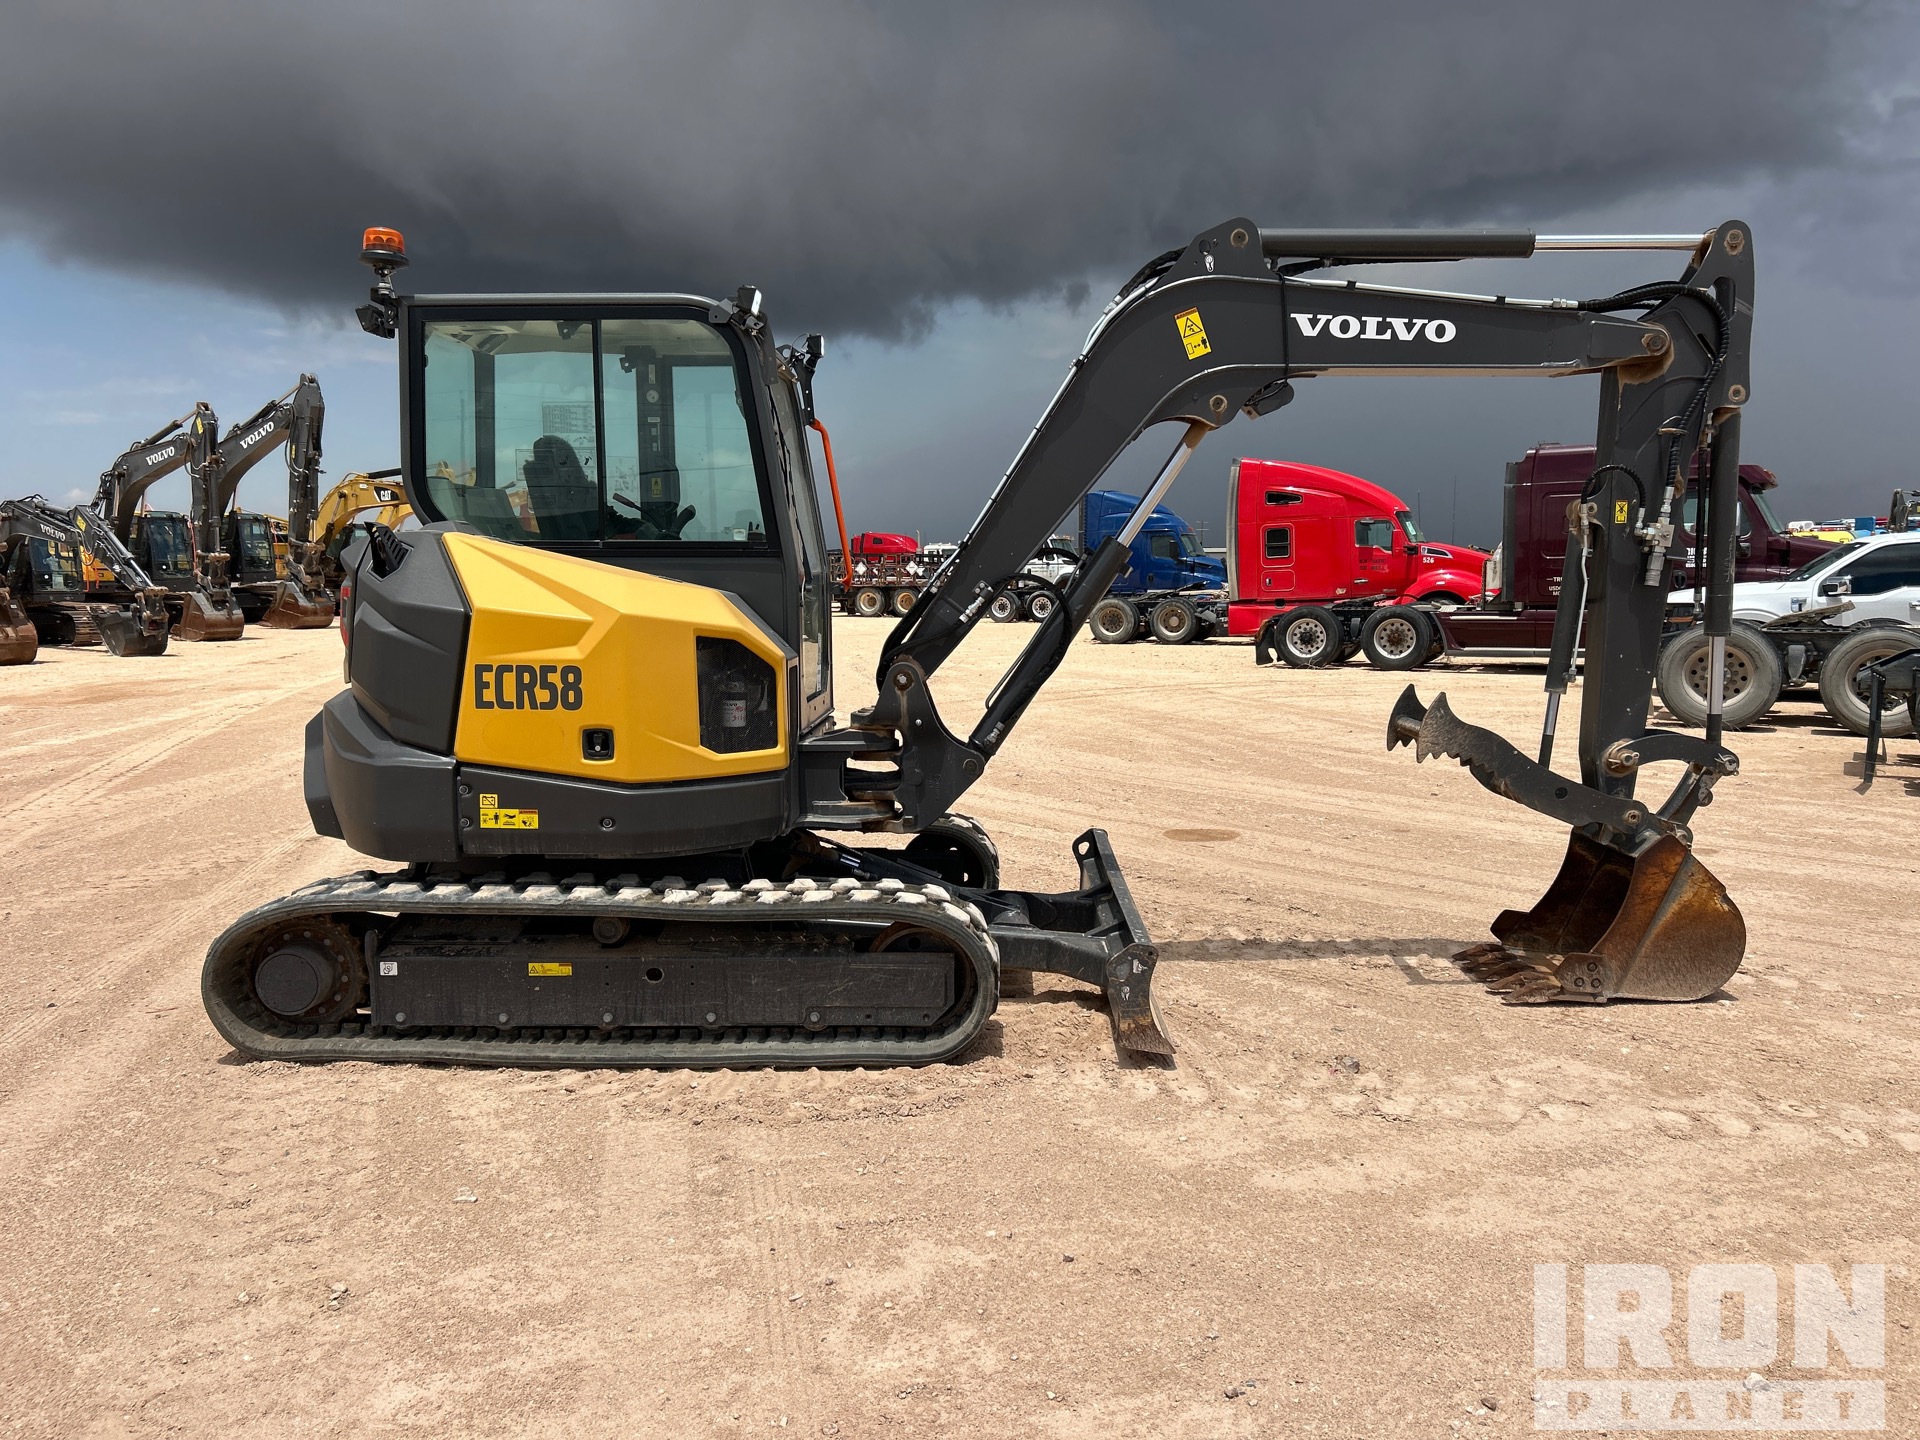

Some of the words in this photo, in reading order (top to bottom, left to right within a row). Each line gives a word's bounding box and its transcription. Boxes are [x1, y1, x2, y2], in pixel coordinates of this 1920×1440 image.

[1290, 313, 1457, 343] VOLVO
[239, 421, 275, 449] VOLVO
[145, 446, 175, 466] VOLVO
[380, 490, 392, 501] CAT
[40, 523, 66, 542] VOLVO
[1422, 556, 1435, 564] 526
[474, 664, 583, 711] ECR58
